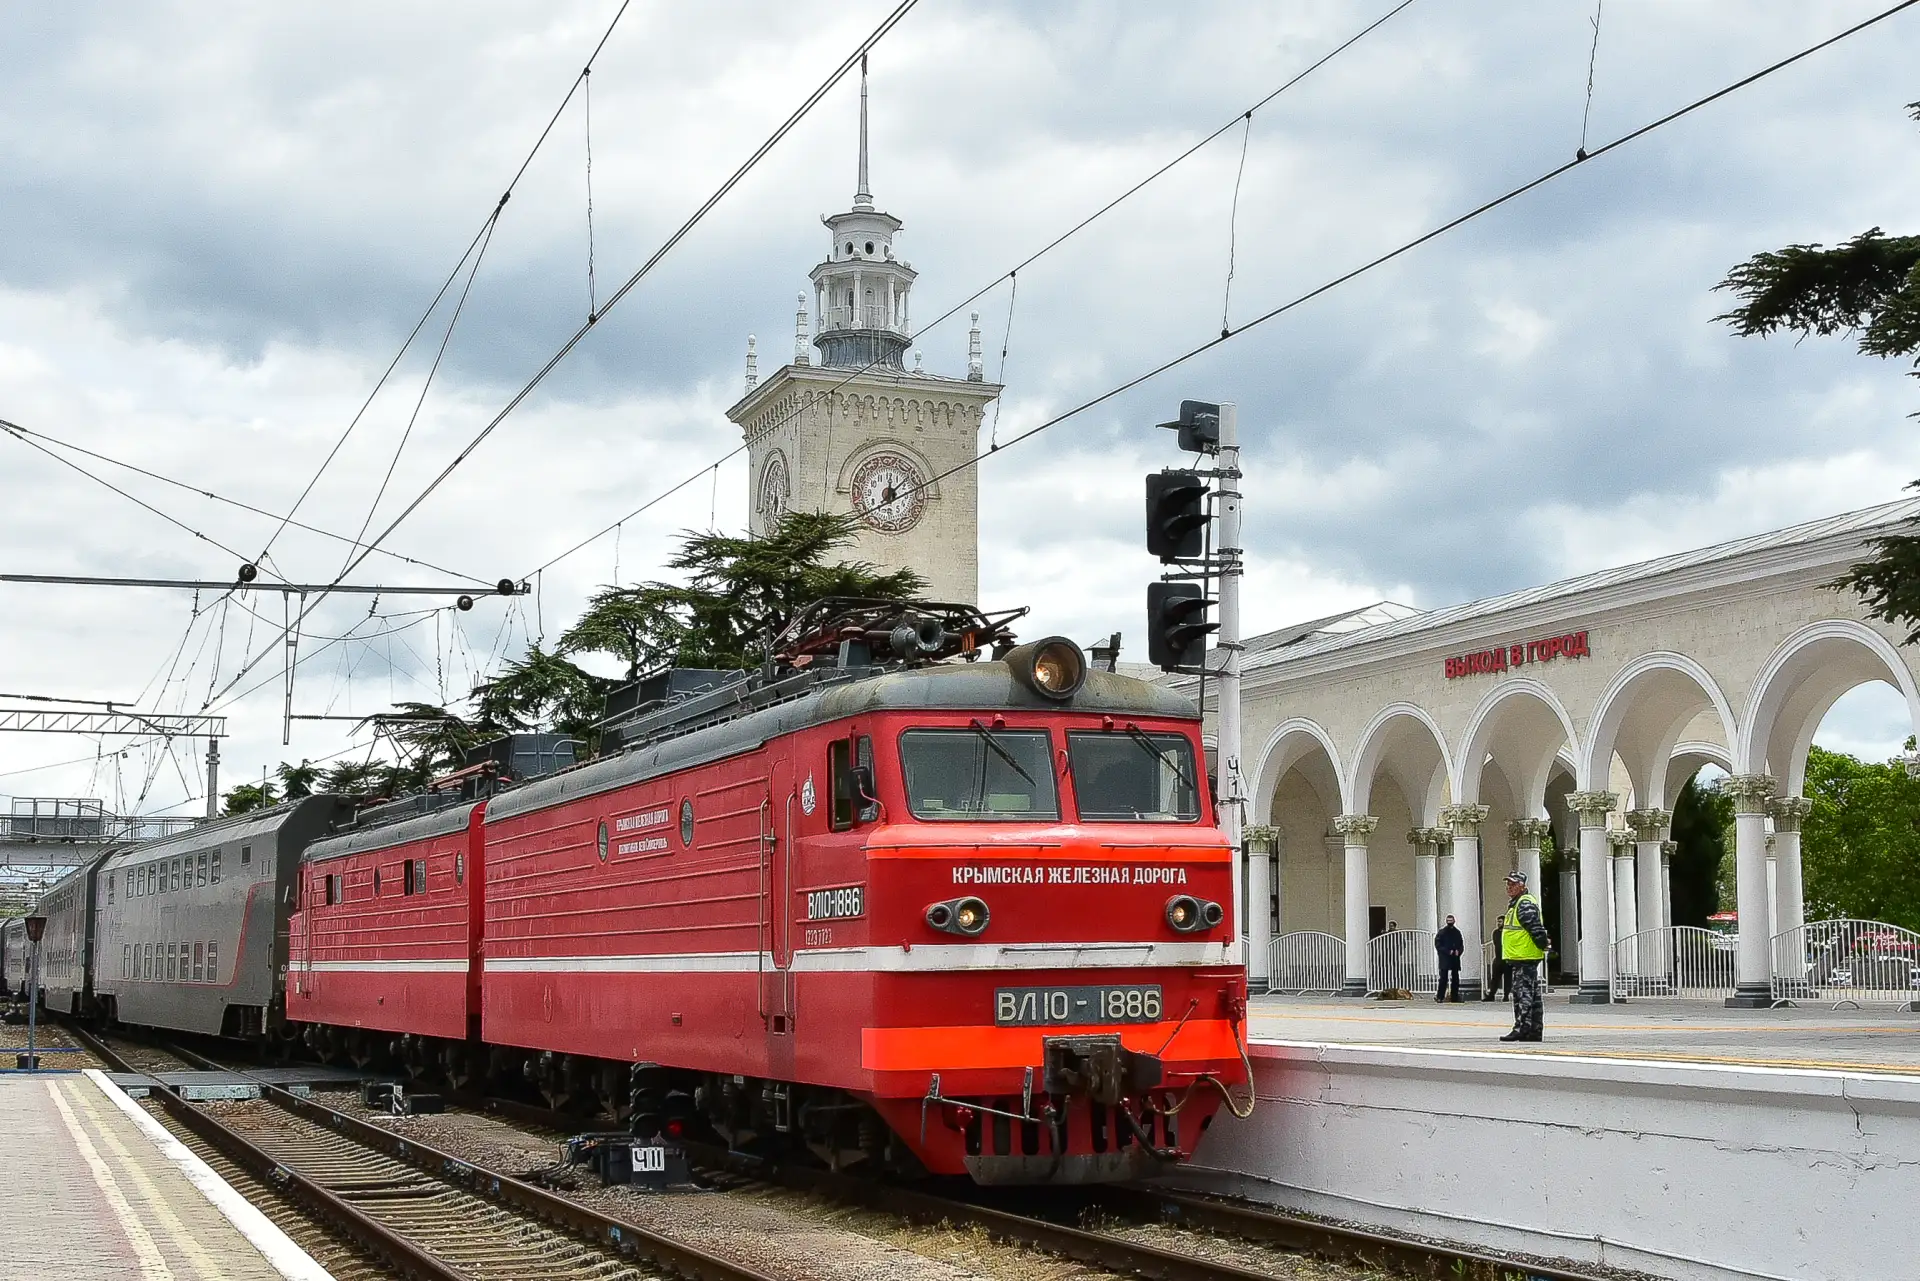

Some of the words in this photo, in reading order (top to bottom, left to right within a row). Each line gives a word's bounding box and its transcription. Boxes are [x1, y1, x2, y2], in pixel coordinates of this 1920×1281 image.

[1445, 647, 1508, 679] ВЫХОД
[1510, 644, 1524, 668] В
[1527, 631, 1591, 663] ГОРОД
[952, 866, 1044, 884] КРЫМСКАЯ
[1047, 866, 1130, 884] ЖЕЛЕЗНАЯ
[1133, 866, 1187, 885] ДОРОГА
[807, 887, 861, 920] ВЛ10-1886
